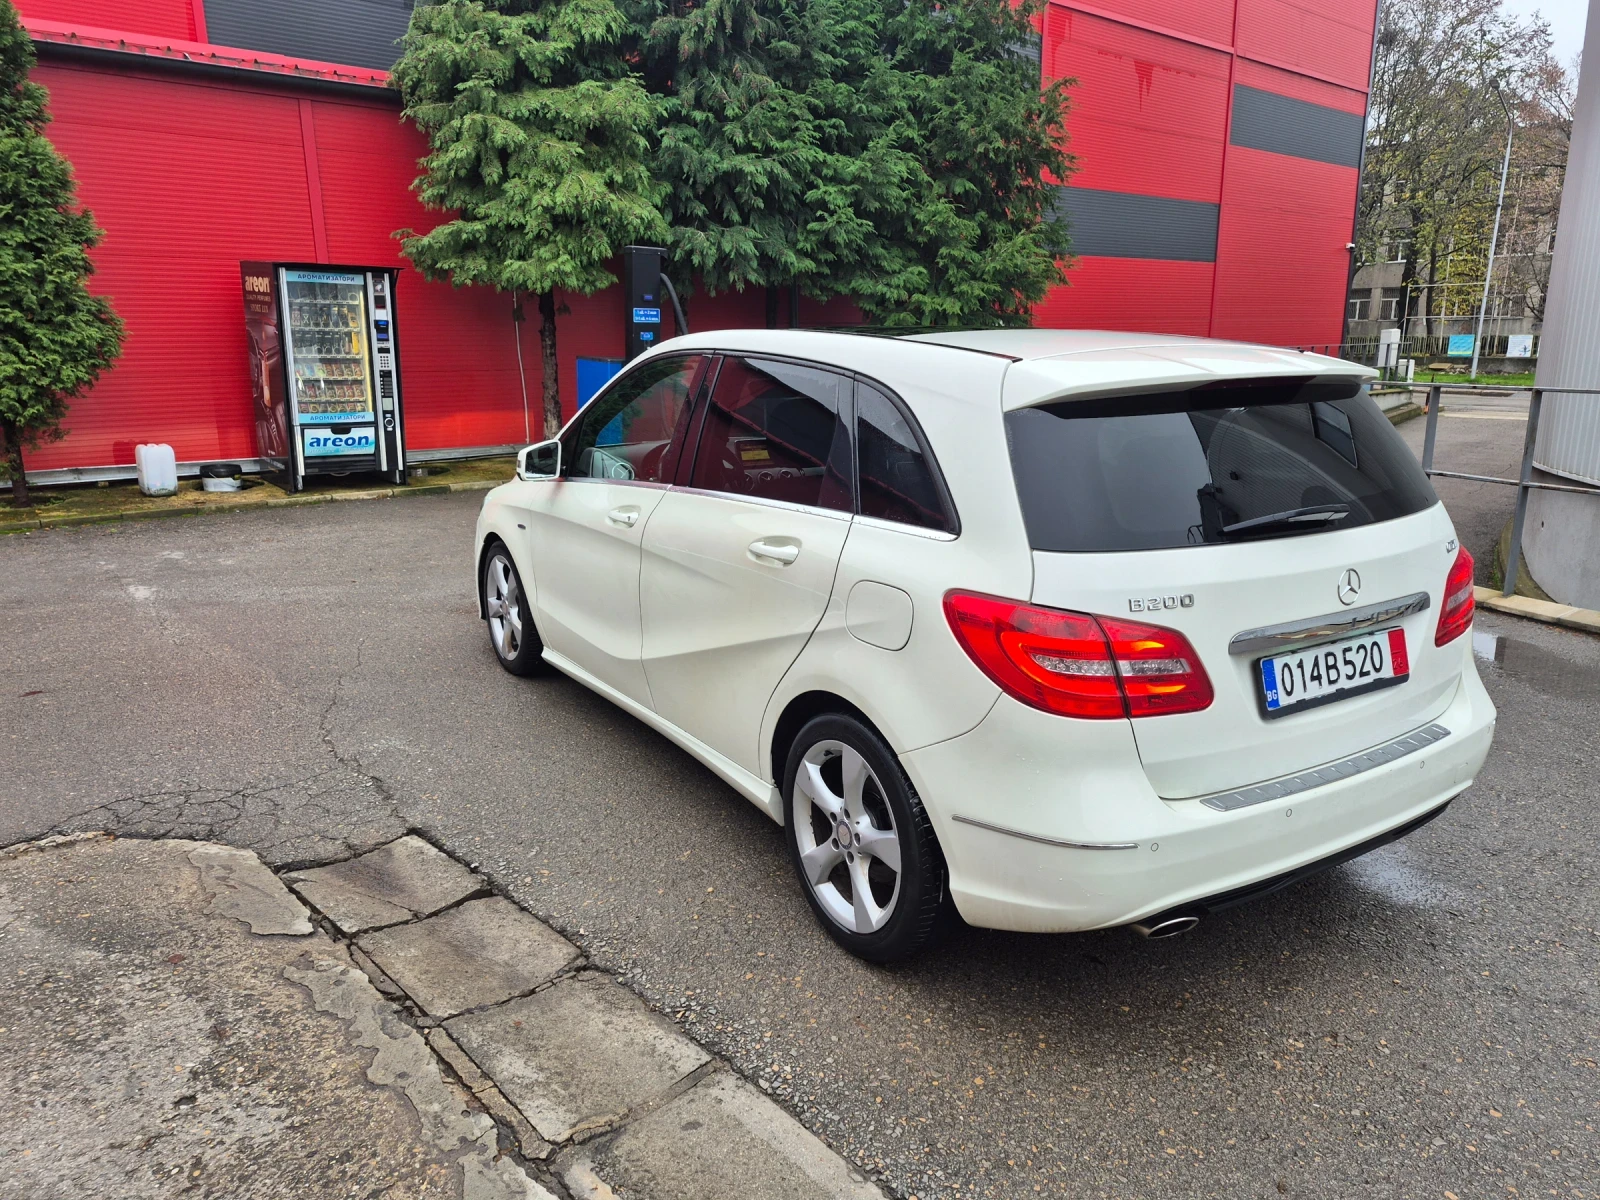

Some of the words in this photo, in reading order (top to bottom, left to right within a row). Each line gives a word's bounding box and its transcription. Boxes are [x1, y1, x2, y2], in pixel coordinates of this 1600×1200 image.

[245, 276, 270, 293] areon
[297, 273, 355, 282] АРОМАТИЗАТОРИ
[309, 435, 370, 447] areon
[1128, 594, 1195, 612] B200
[1281, 641, 1383, 697] 014B520
[1267, 690, 1278, 702] BG
